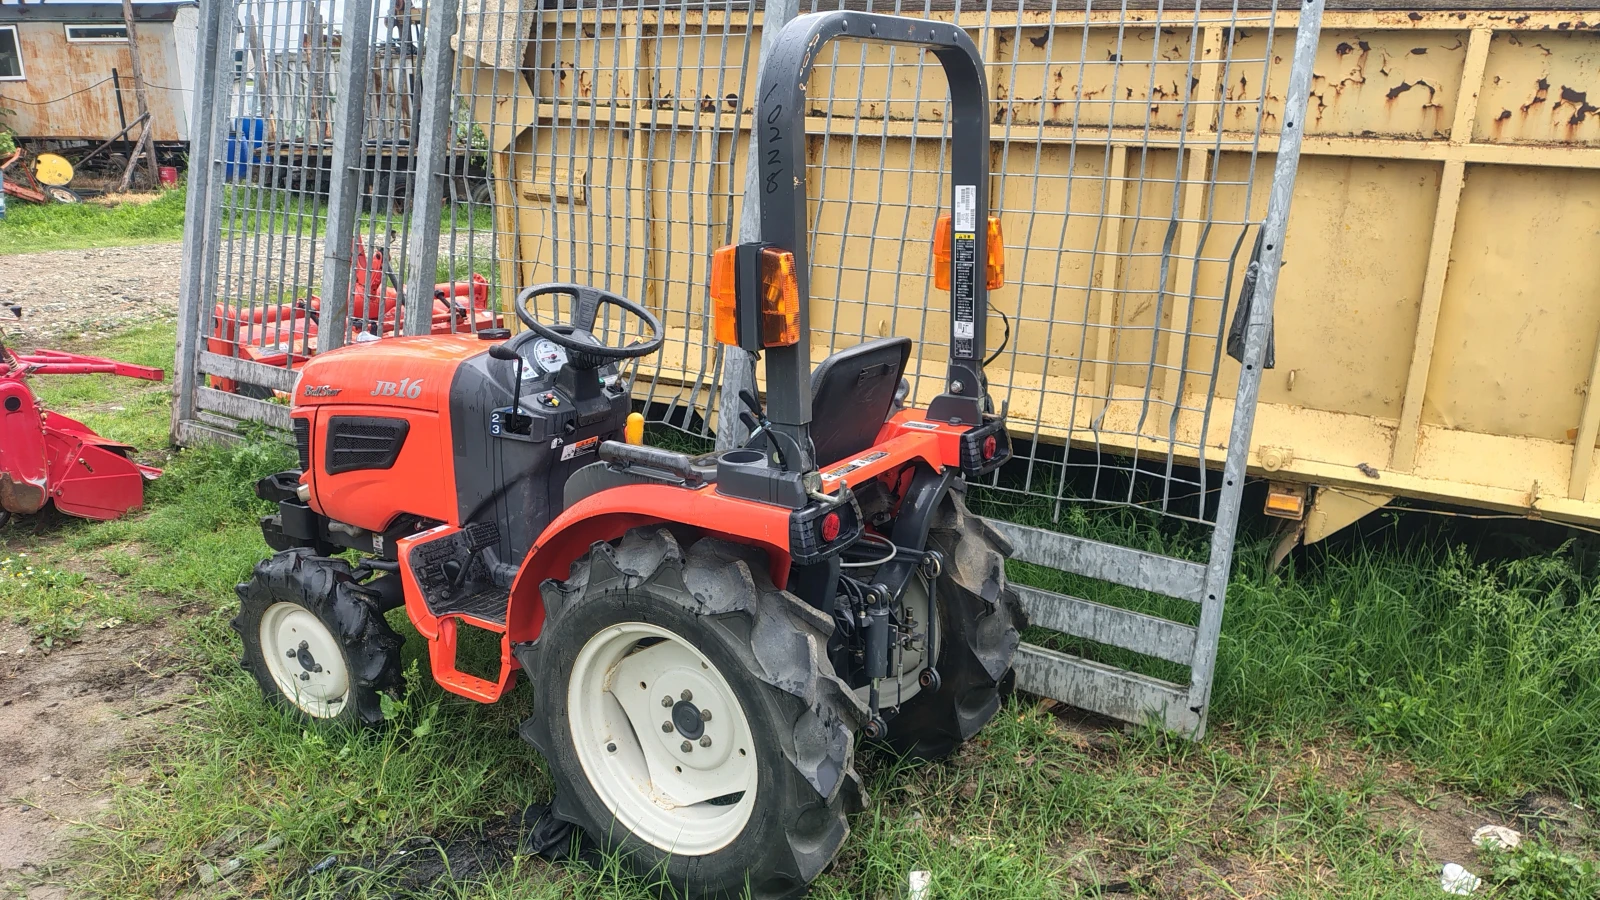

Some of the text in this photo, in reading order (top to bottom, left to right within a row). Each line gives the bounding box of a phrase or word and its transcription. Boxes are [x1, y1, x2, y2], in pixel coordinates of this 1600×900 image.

[763, 83, 783, 194] 10228
[370, 377, 424, 399] JB16
[492, 413, 500, 423] 2
[492, 424, 500, 434] 3
